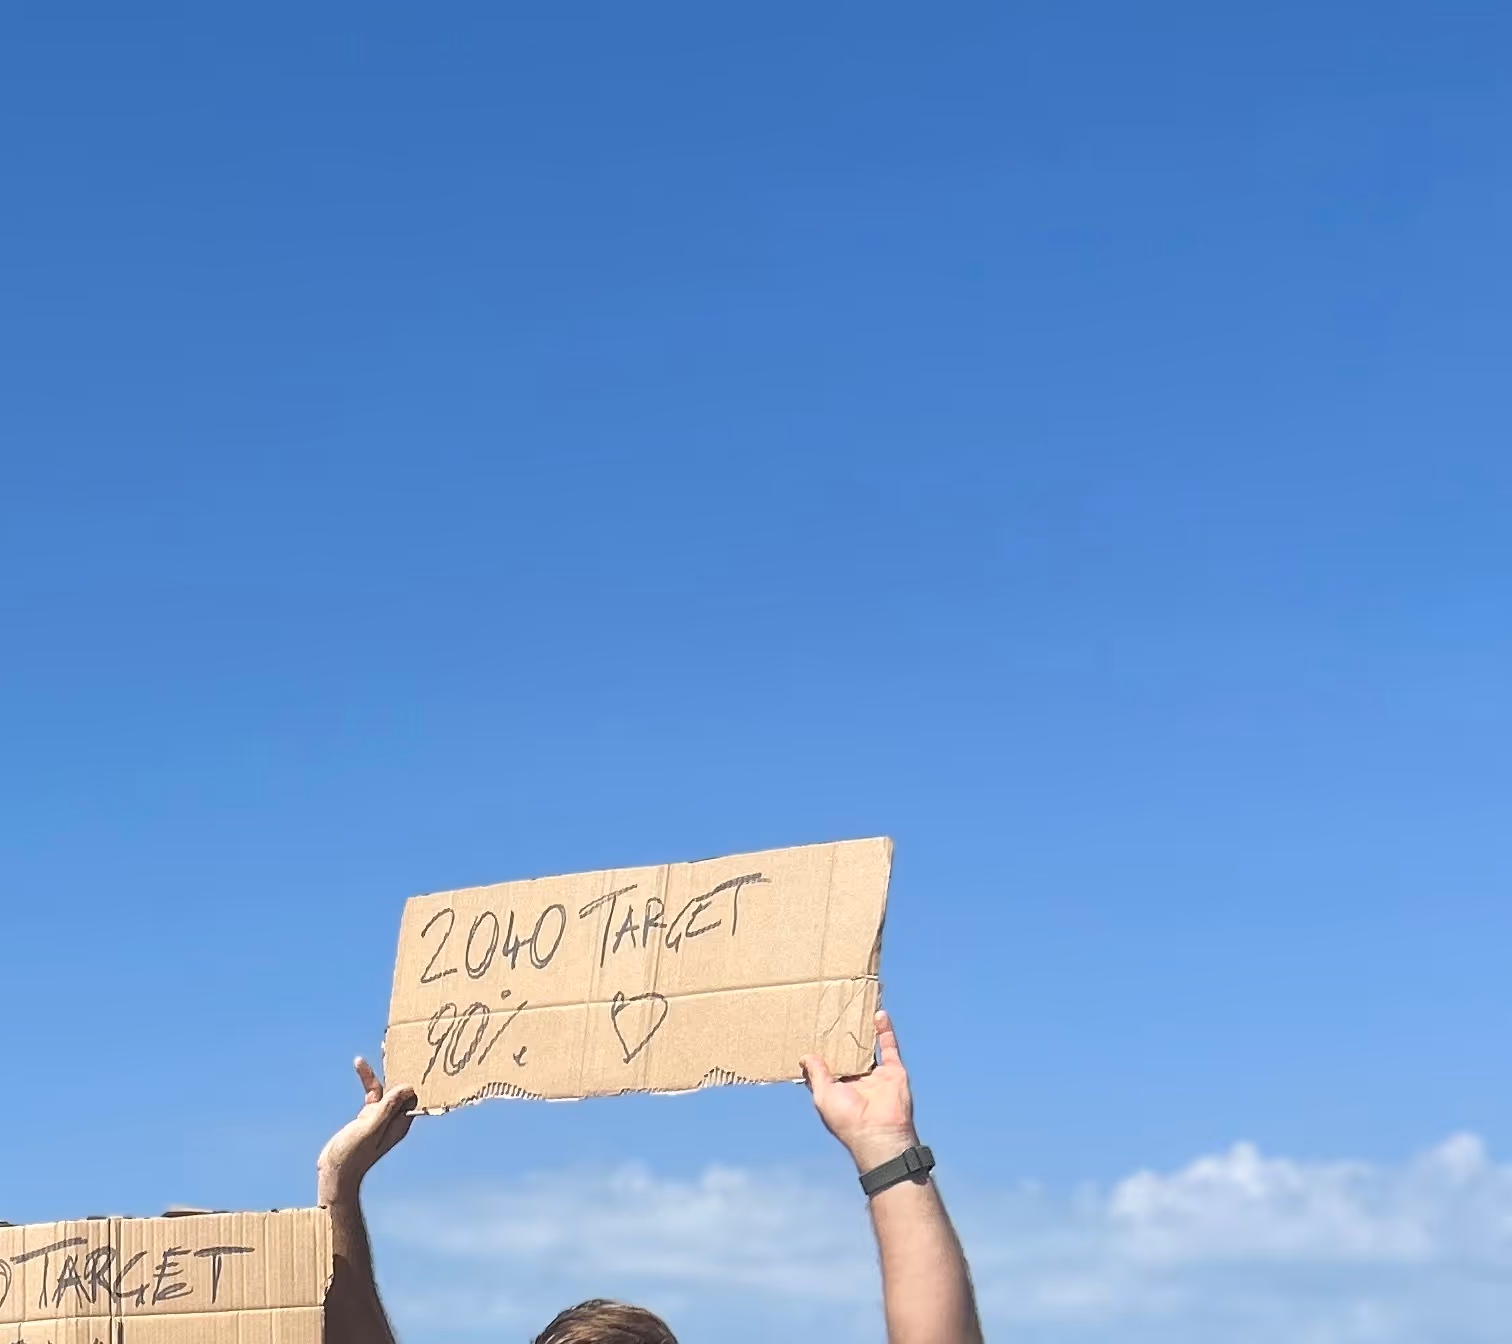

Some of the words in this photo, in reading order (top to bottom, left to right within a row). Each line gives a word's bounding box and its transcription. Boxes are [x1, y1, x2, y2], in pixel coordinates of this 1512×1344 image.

[419, 903, 567, 985] 2040
[579, 872, 771, 968] TARGET
[421, 990, 529, 1086] 90%
[11, 1237, 255, 1309] TARGET
